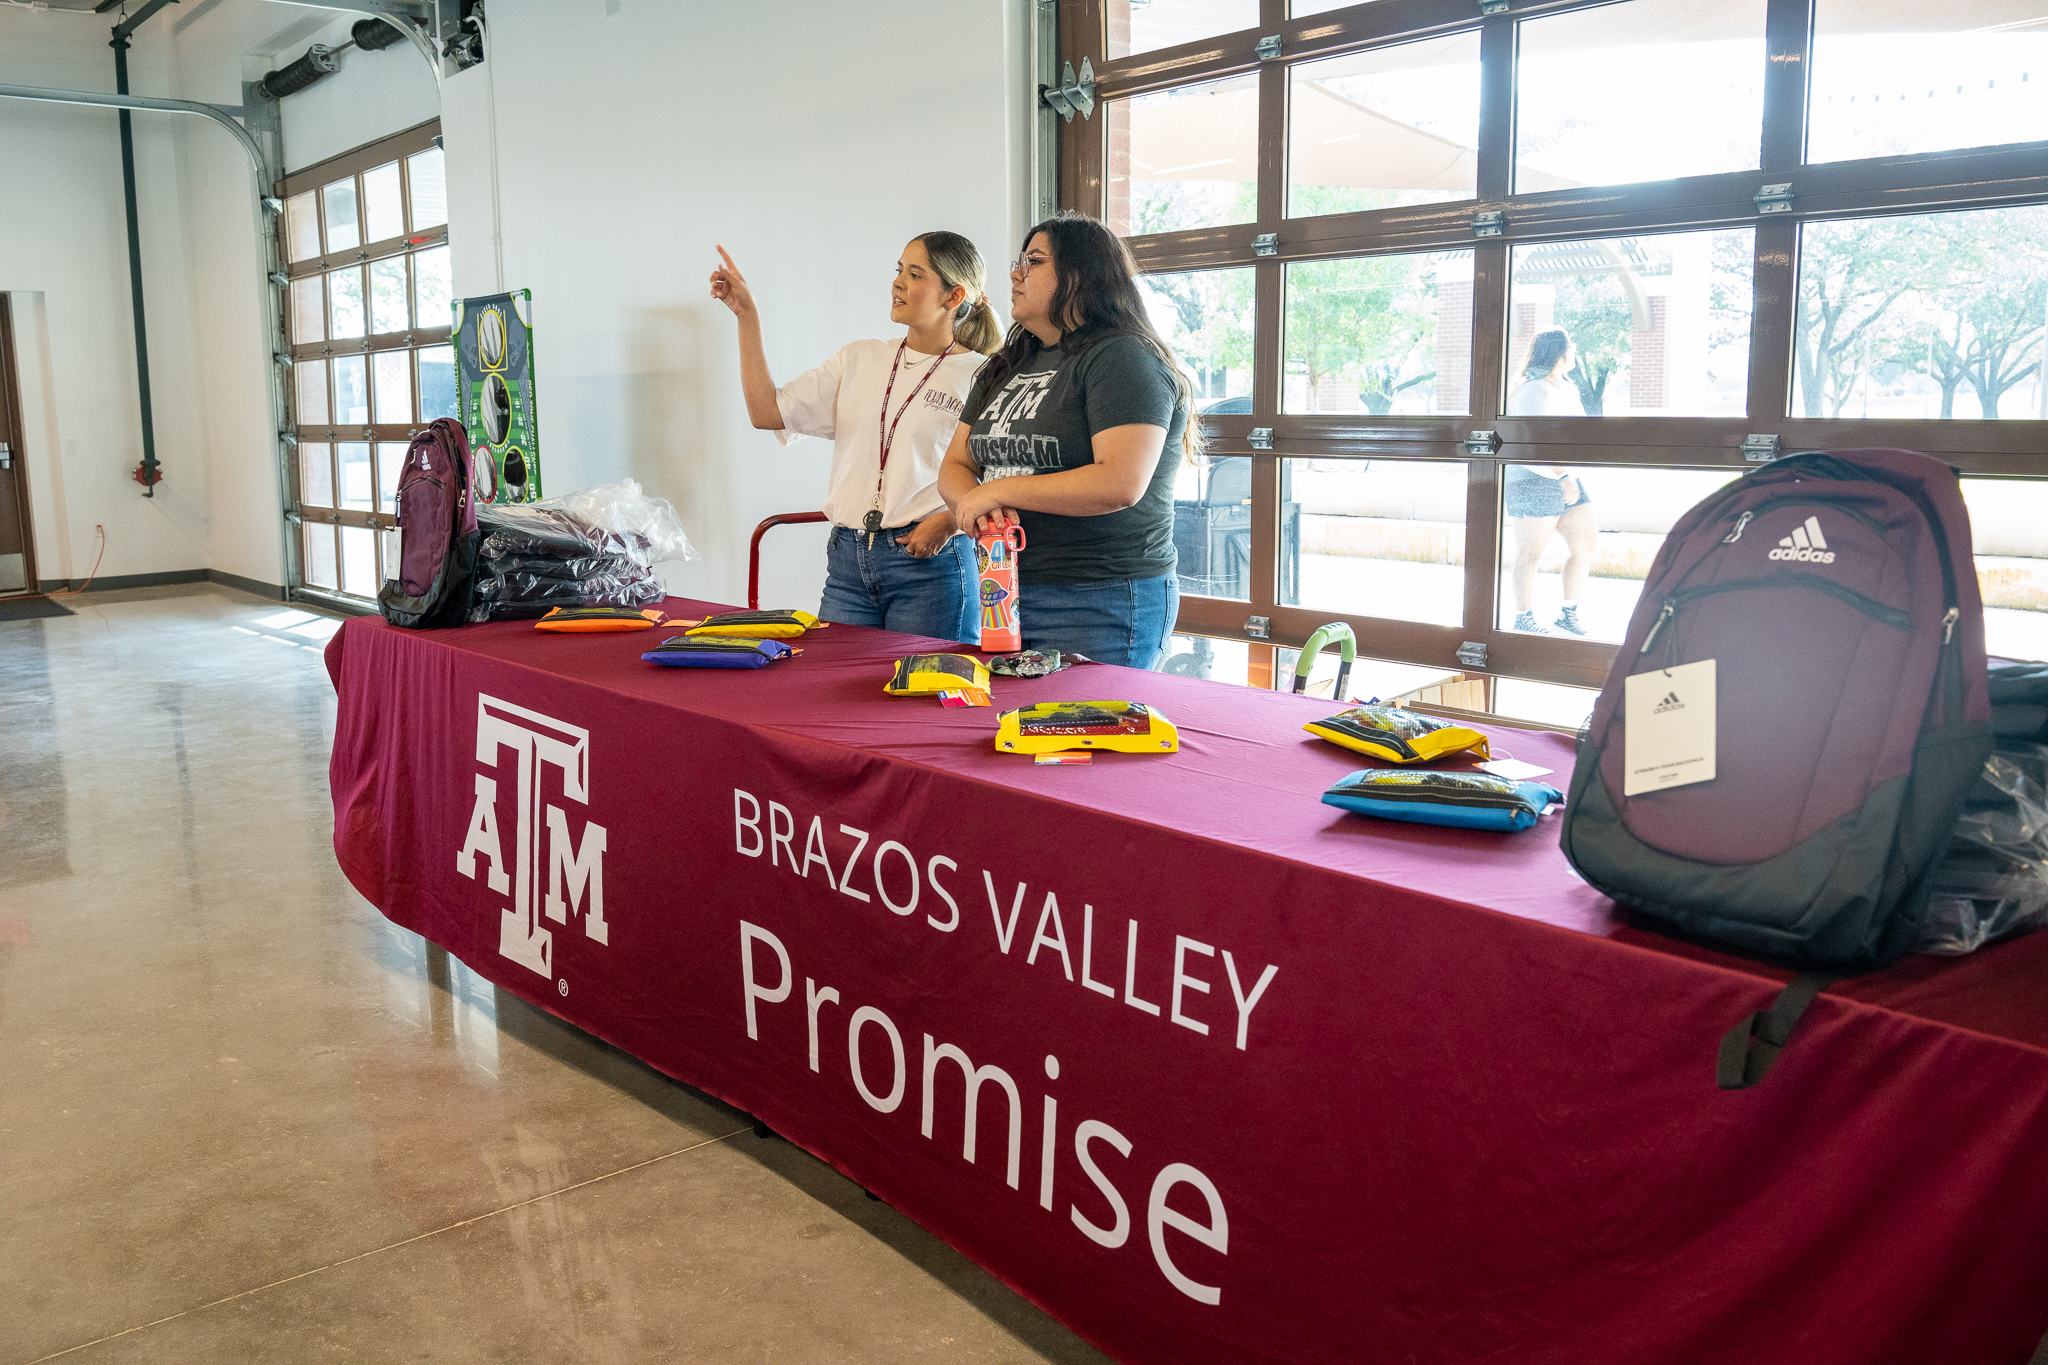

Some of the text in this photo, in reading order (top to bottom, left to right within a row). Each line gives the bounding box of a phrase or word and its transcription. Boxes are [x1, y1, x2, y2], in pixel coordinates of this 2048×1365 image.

[924, 388, 947, 406] TEXAS
[944, 396, 965, 413] AGGI
[1768, 546, 1836, 564] adidas
[734, 787, 1279, 1052] BRAZOS VALLEY
[739, 918, 1230, 1306] Promise
